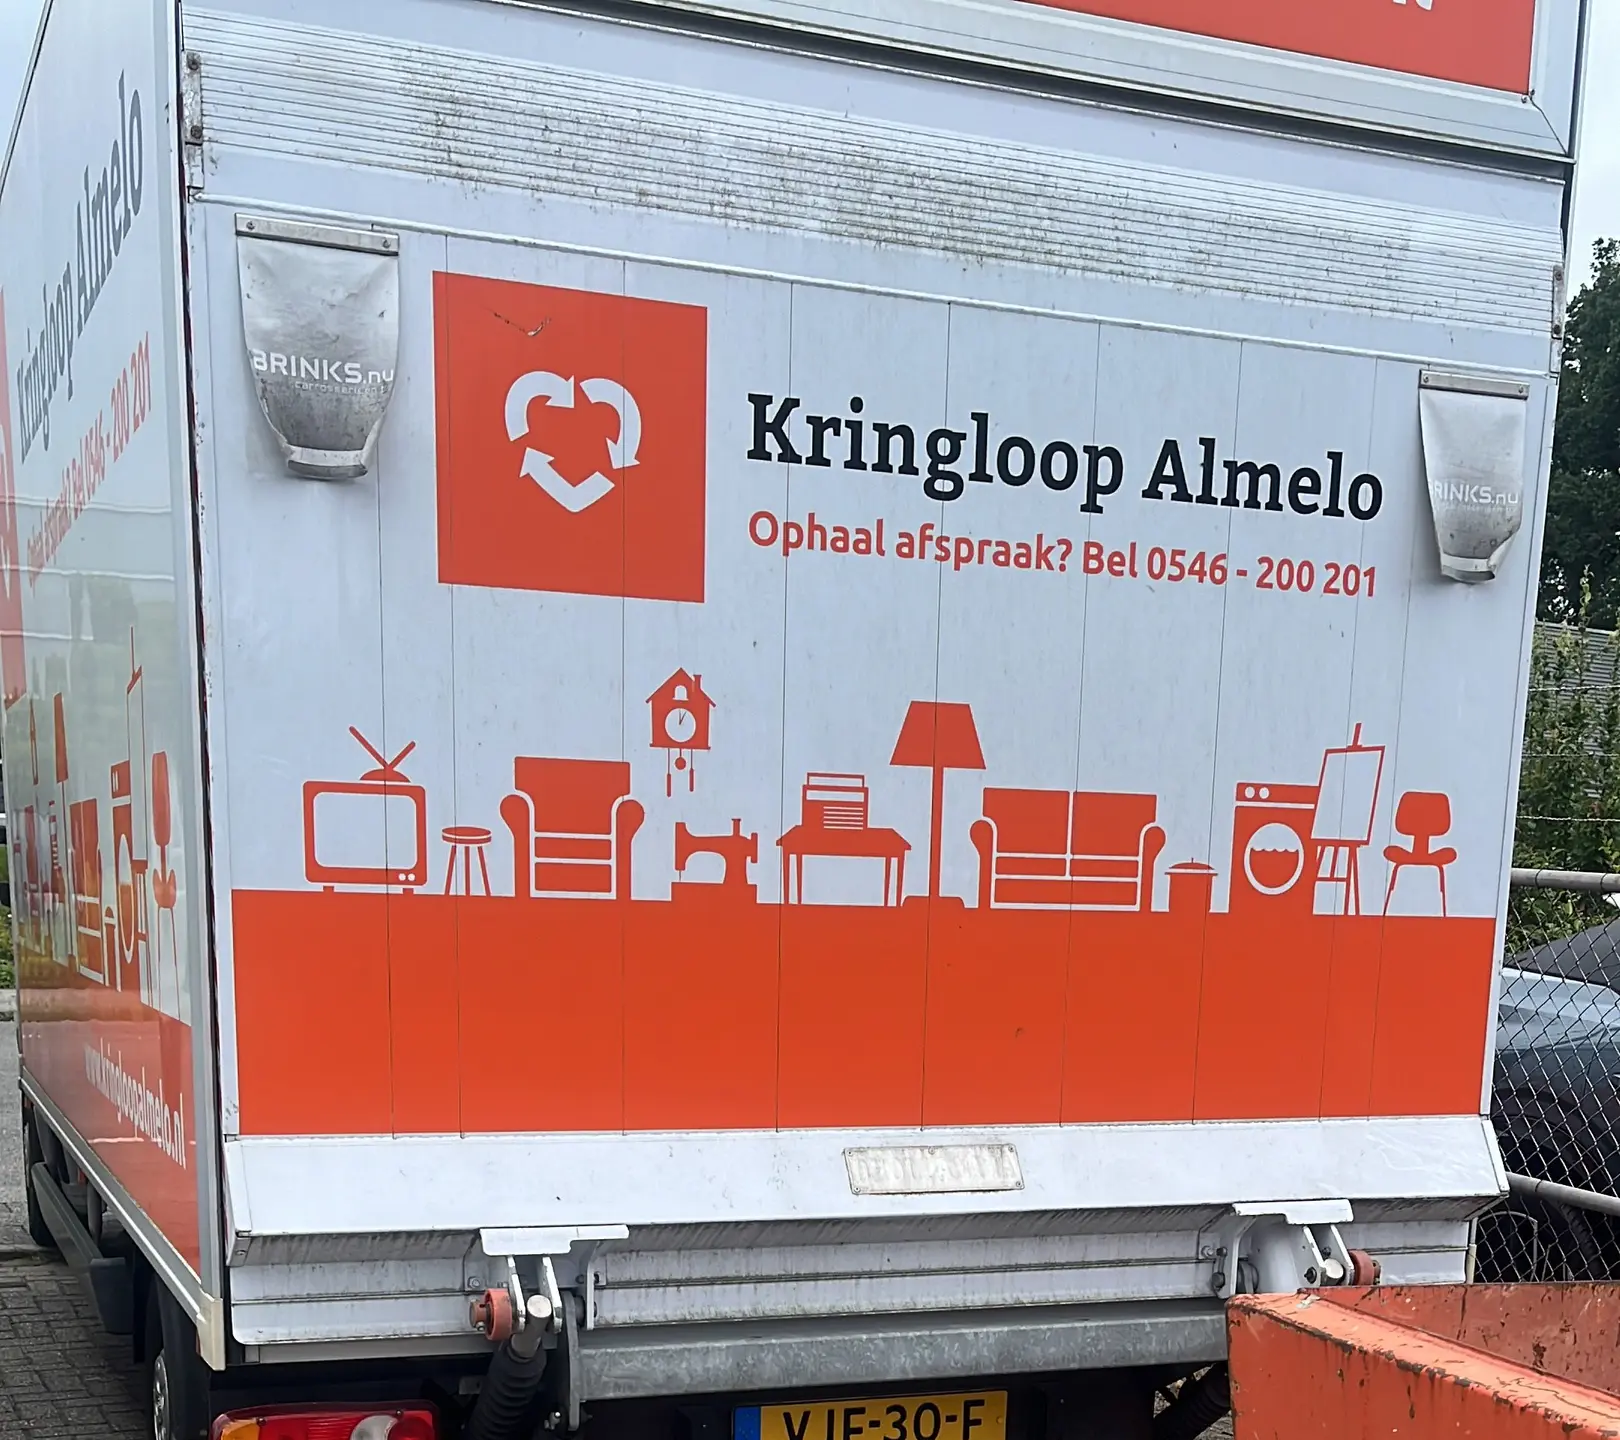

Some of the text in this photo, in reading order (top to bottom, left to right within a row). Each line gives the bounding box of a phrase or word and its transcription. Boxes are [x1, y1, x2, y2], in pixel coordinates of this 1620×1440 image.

[17, 261, 73, 464] Kringloop
[77, 69, 143, 339] Almelo
[111, 367, 130, 463] 200
[131, 331, 151, 433] 201
[251, 348, 394, 384] BRINKS.nu
[746, 392, 1384, 521] Kringloop Almelo
[1431, 481, 1518, 504] RINKS.nu
[749, 510, 1376, 598] Ophaal afspraak? Bel 0546 - 200 201
